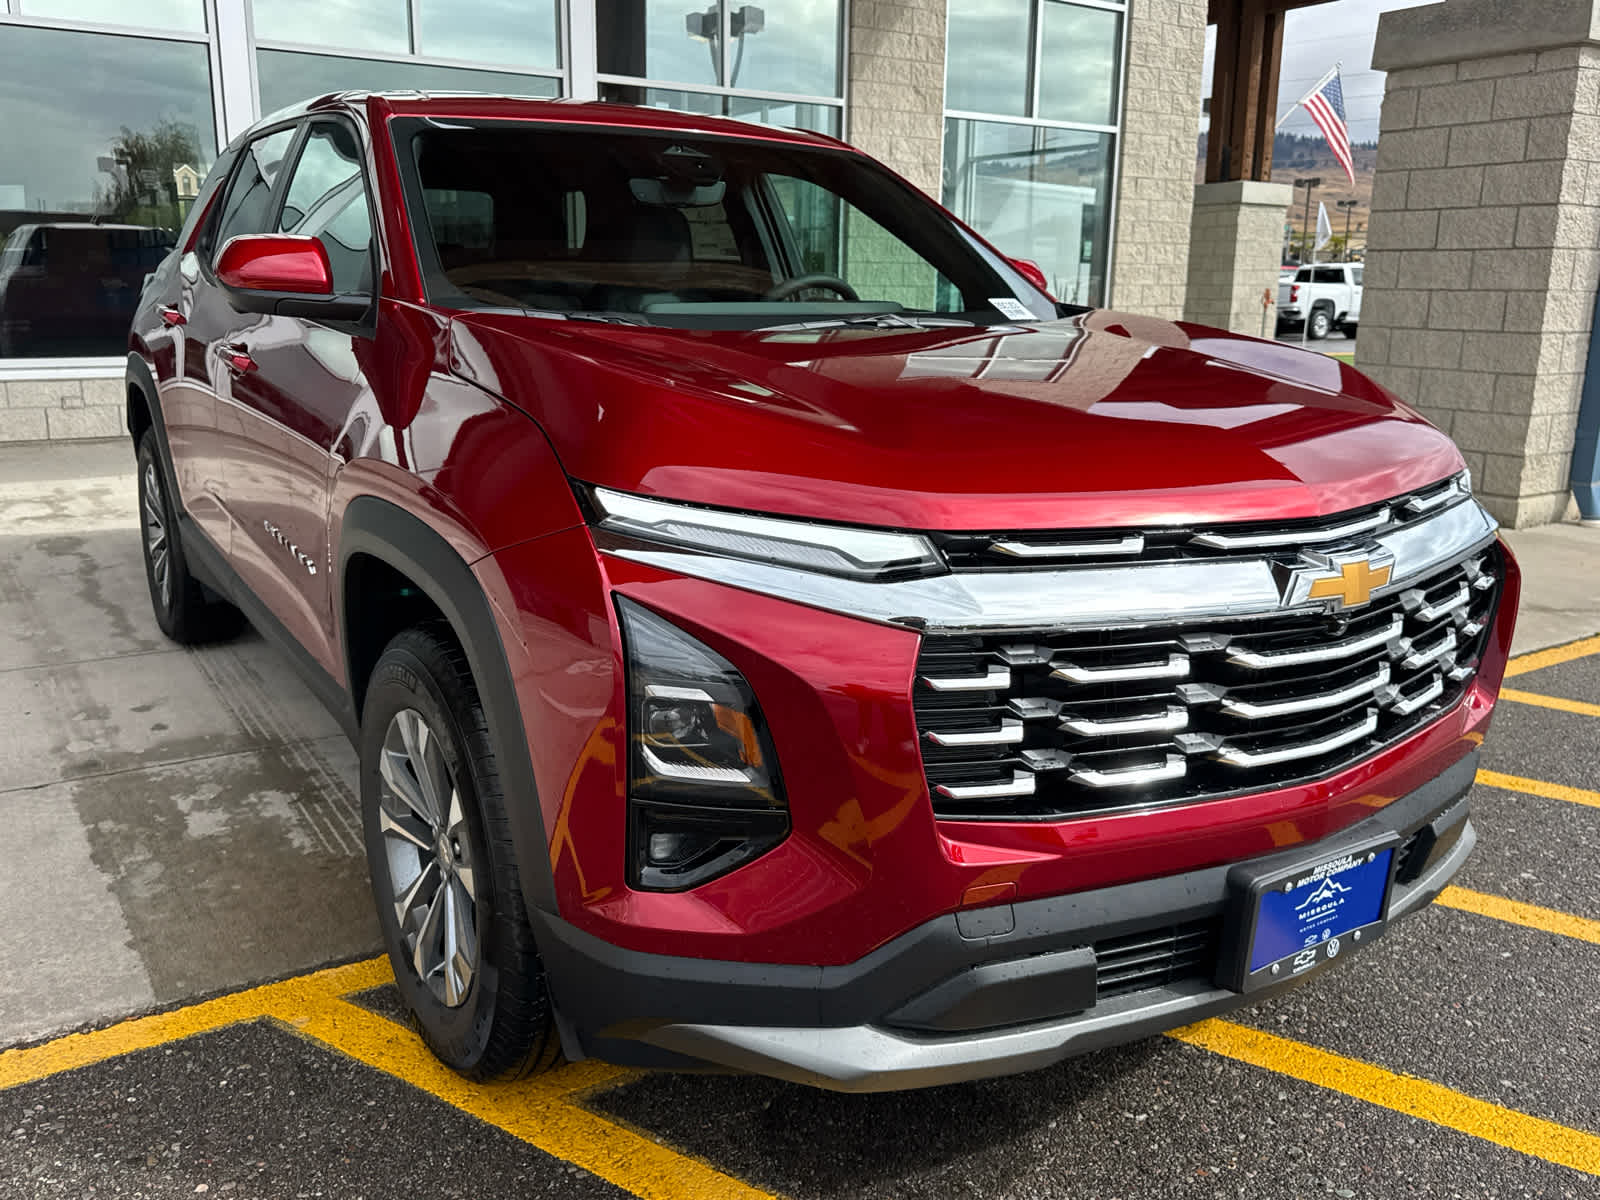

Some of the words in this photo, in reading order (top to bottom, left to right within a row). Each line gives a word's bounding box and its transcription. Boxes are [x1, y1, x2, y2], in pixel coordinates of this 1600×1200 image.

[1297, 872, 1326, 888] MOTOR
[1326, 857, 1364, 876] COMPANY
[1314, 855, 1352, 875] MISSOULA
[1299, 898, 1344, 920] MISSOULA
